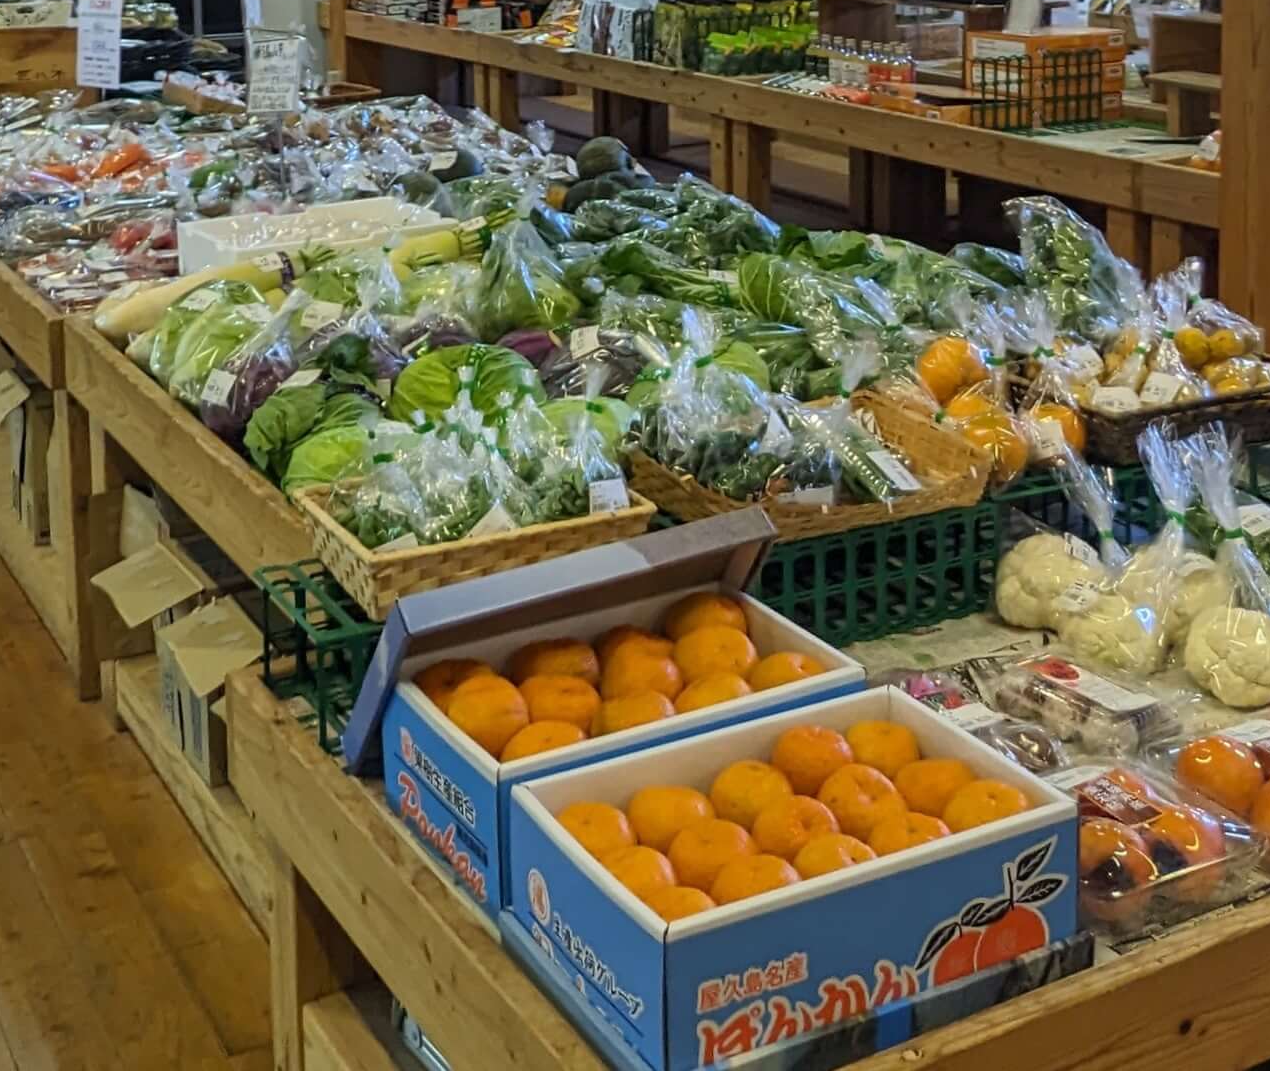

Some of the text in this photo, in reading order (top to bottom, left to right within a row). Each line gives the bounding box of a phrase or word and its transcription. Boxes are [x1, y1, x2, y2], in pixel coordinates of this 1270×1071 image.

[695, 958, 922, 1068] ぽんかん
[696, 951, 809, 1016] 屋久島名産
